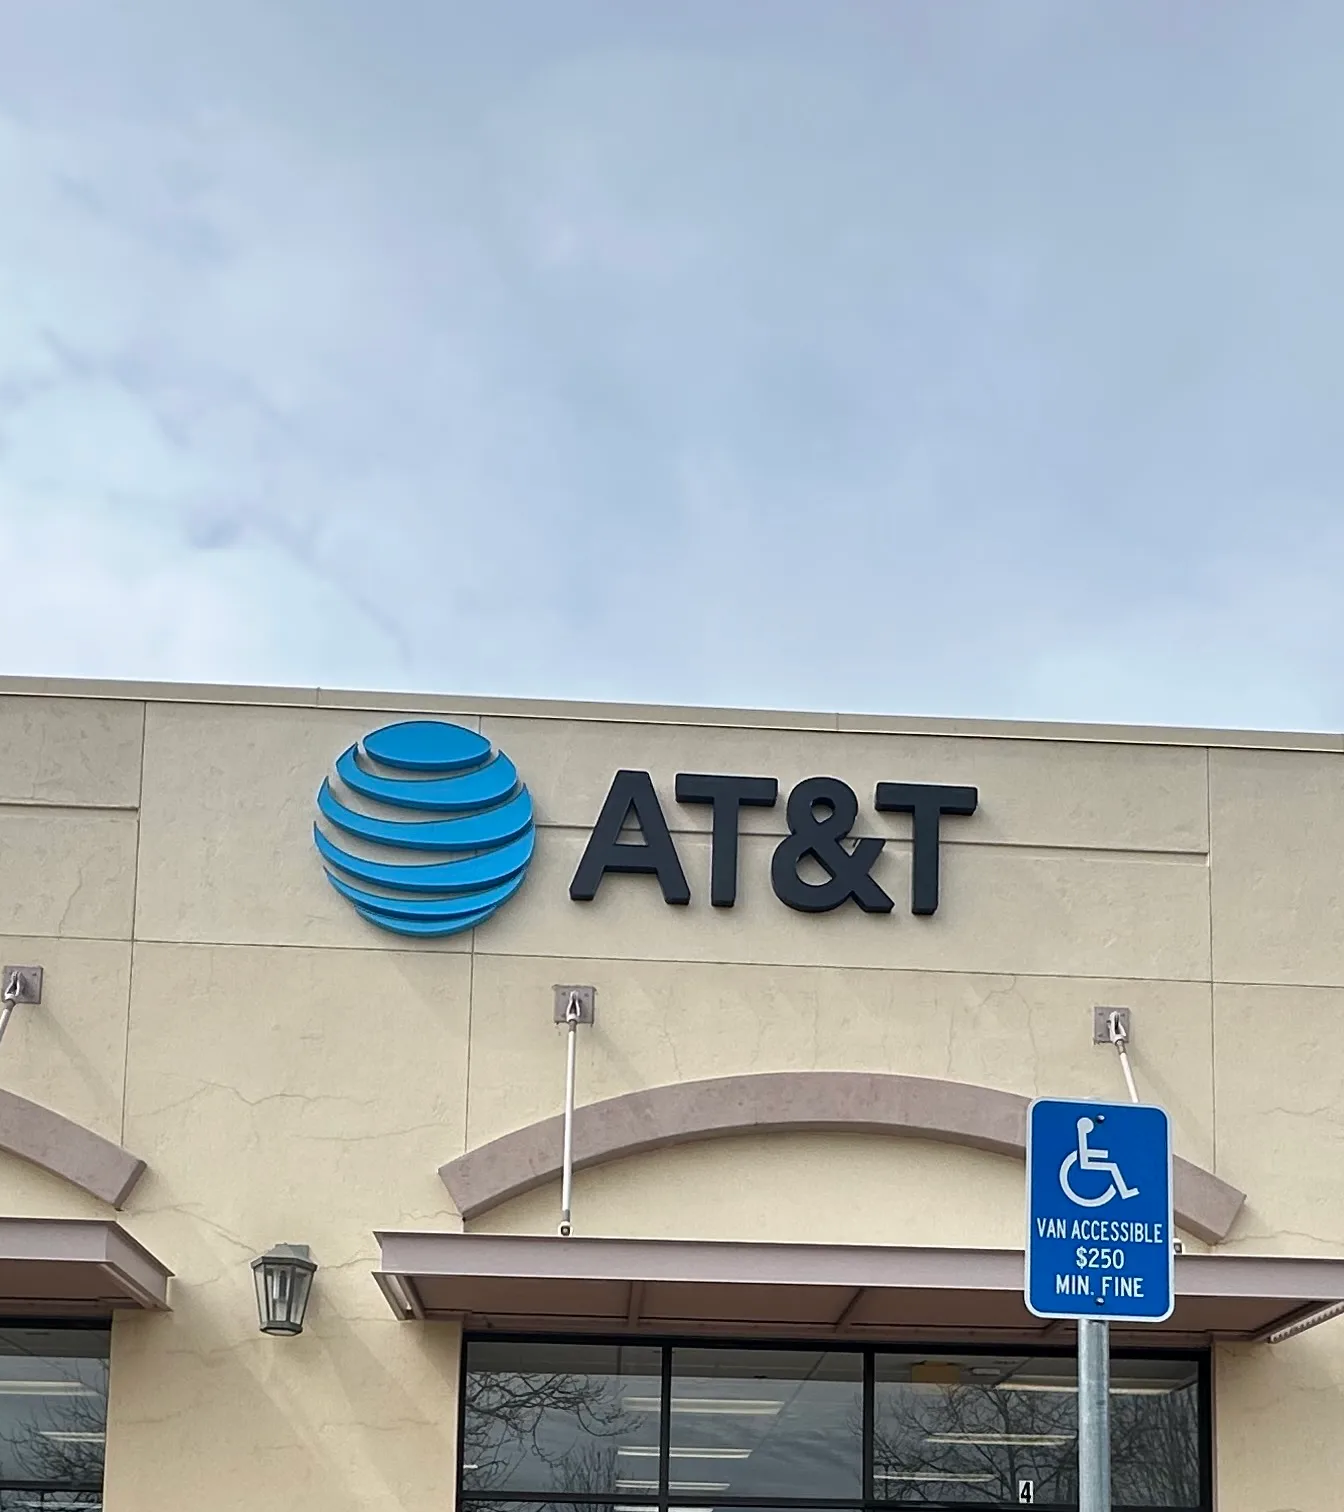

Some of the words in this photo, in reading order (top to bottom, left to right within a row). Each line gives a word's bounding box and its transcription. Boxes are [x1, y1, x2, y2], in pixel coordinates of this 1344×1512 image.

[569, 769, 978, 916] AT&T
[1036, 1217, 1067, 1240] VAN
[1071, 1219, 1163, 1244] ACCESSIBLE
[1075, 1246, 1125, 1270] $250
[1056, 1274, 1095, 1296] MIN.
[1102, 1276, 1145, 1298] FINE
[1020, 1481, 1032, 1503] 4
